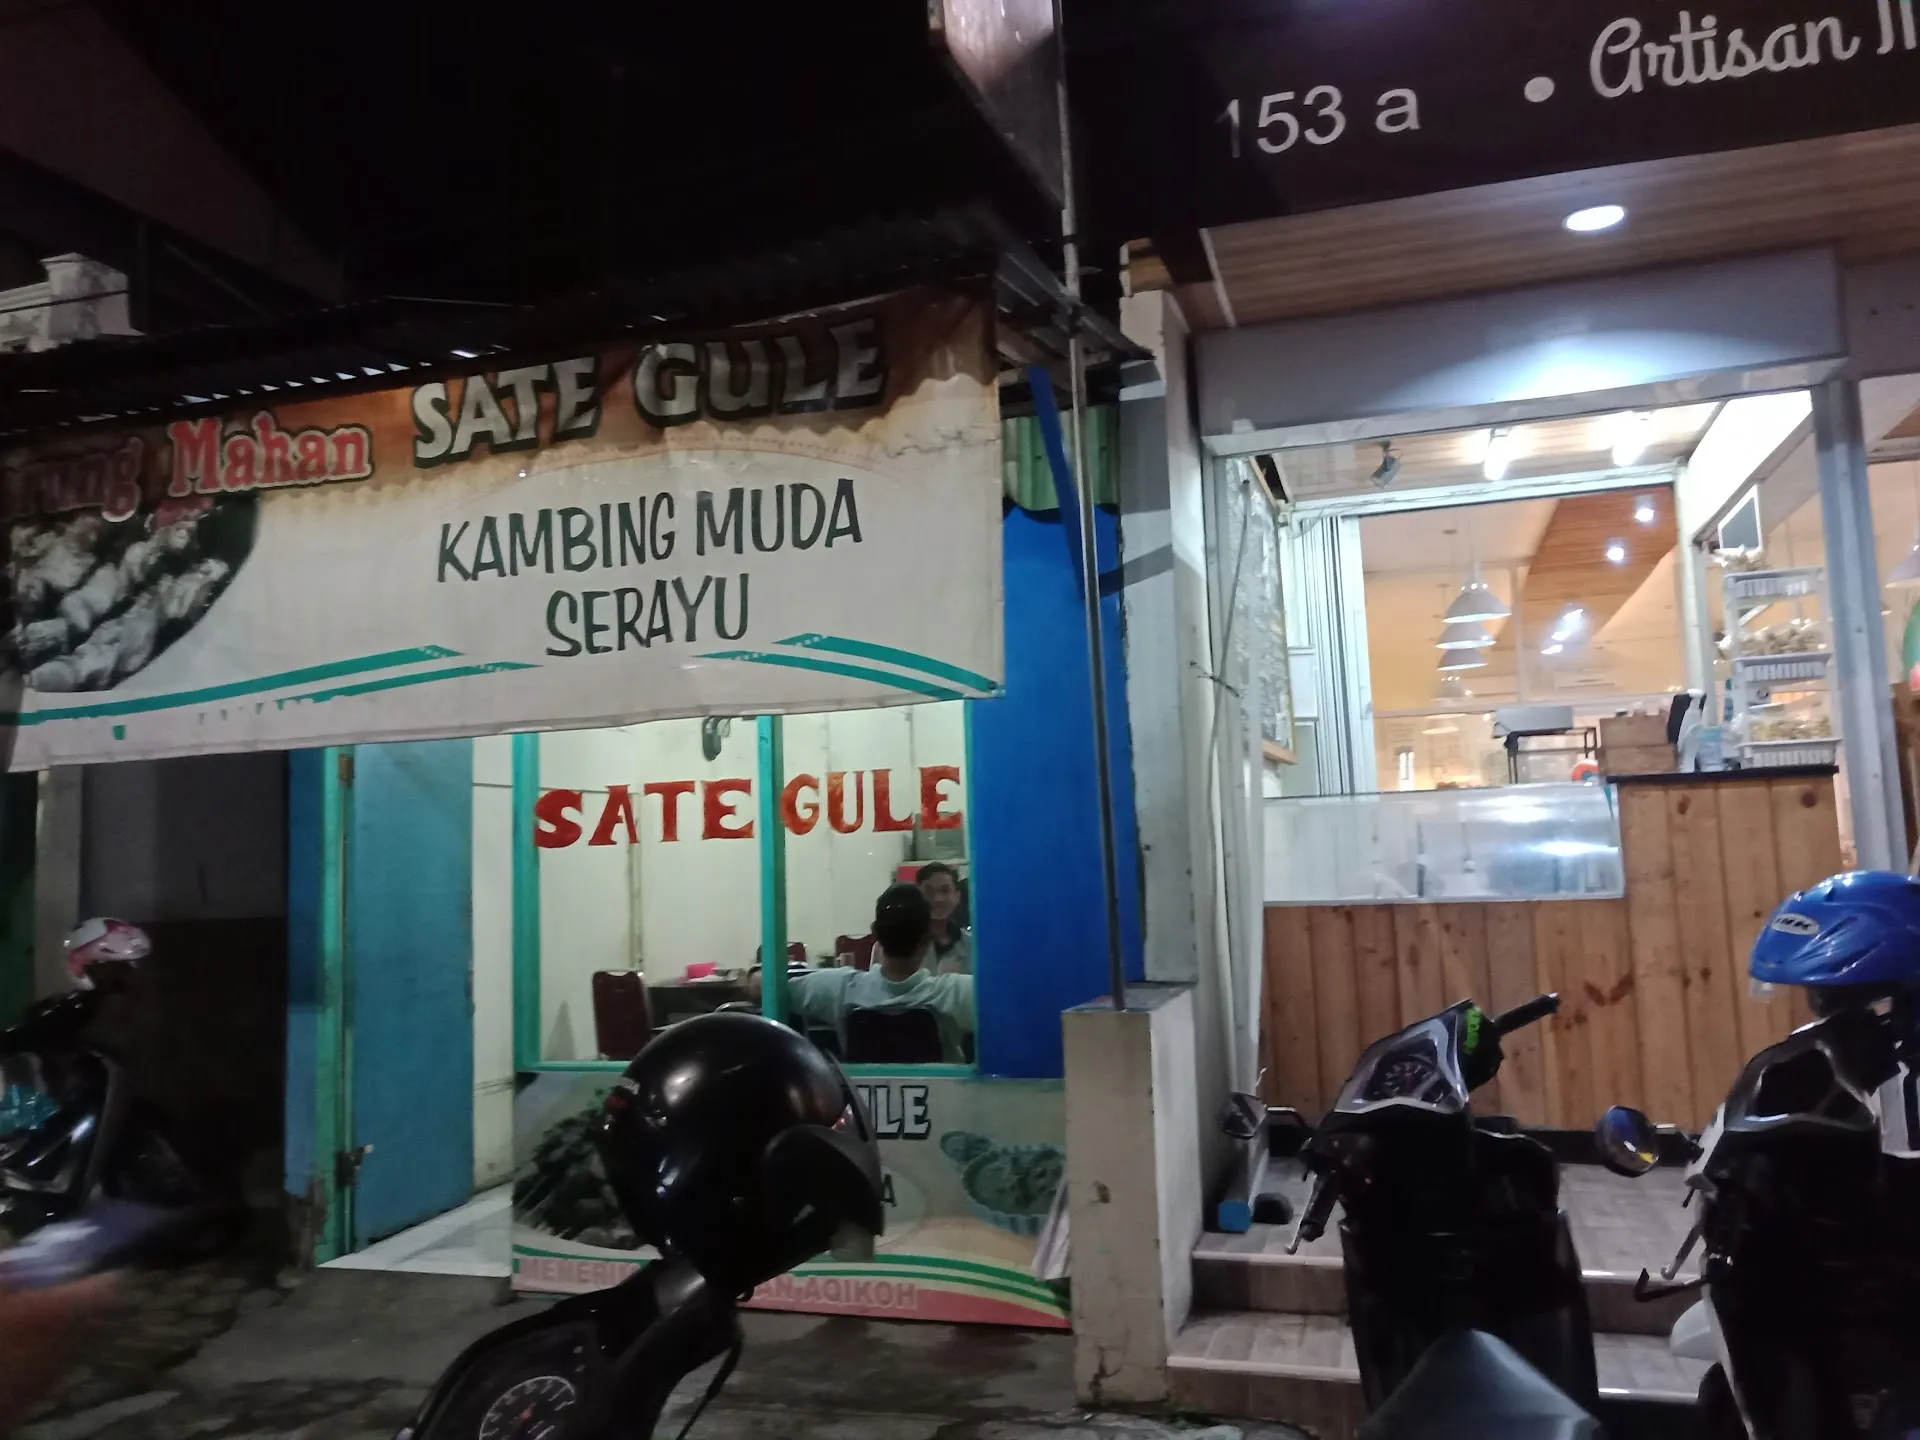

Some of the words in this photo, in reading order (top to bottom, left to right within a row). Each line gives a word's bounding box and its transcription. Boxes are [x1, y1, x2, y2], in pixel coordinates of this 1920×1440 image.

[1215, 84, 1347, 159] 153
[1375, 87, 1421, 134] a
[1590, 10, 1862, 99] Artisan
[411, 357, 600, 469] SATE
[633, 318, 886, 428] GULE
[438, 492, 676, 582] KAMBING
[695, 478, 863, 556] MUDA
[545, 573, 749, 658] SERAYU
[533, 778, 756, 850] SATE
[780, 766, 962, 836] GULE
